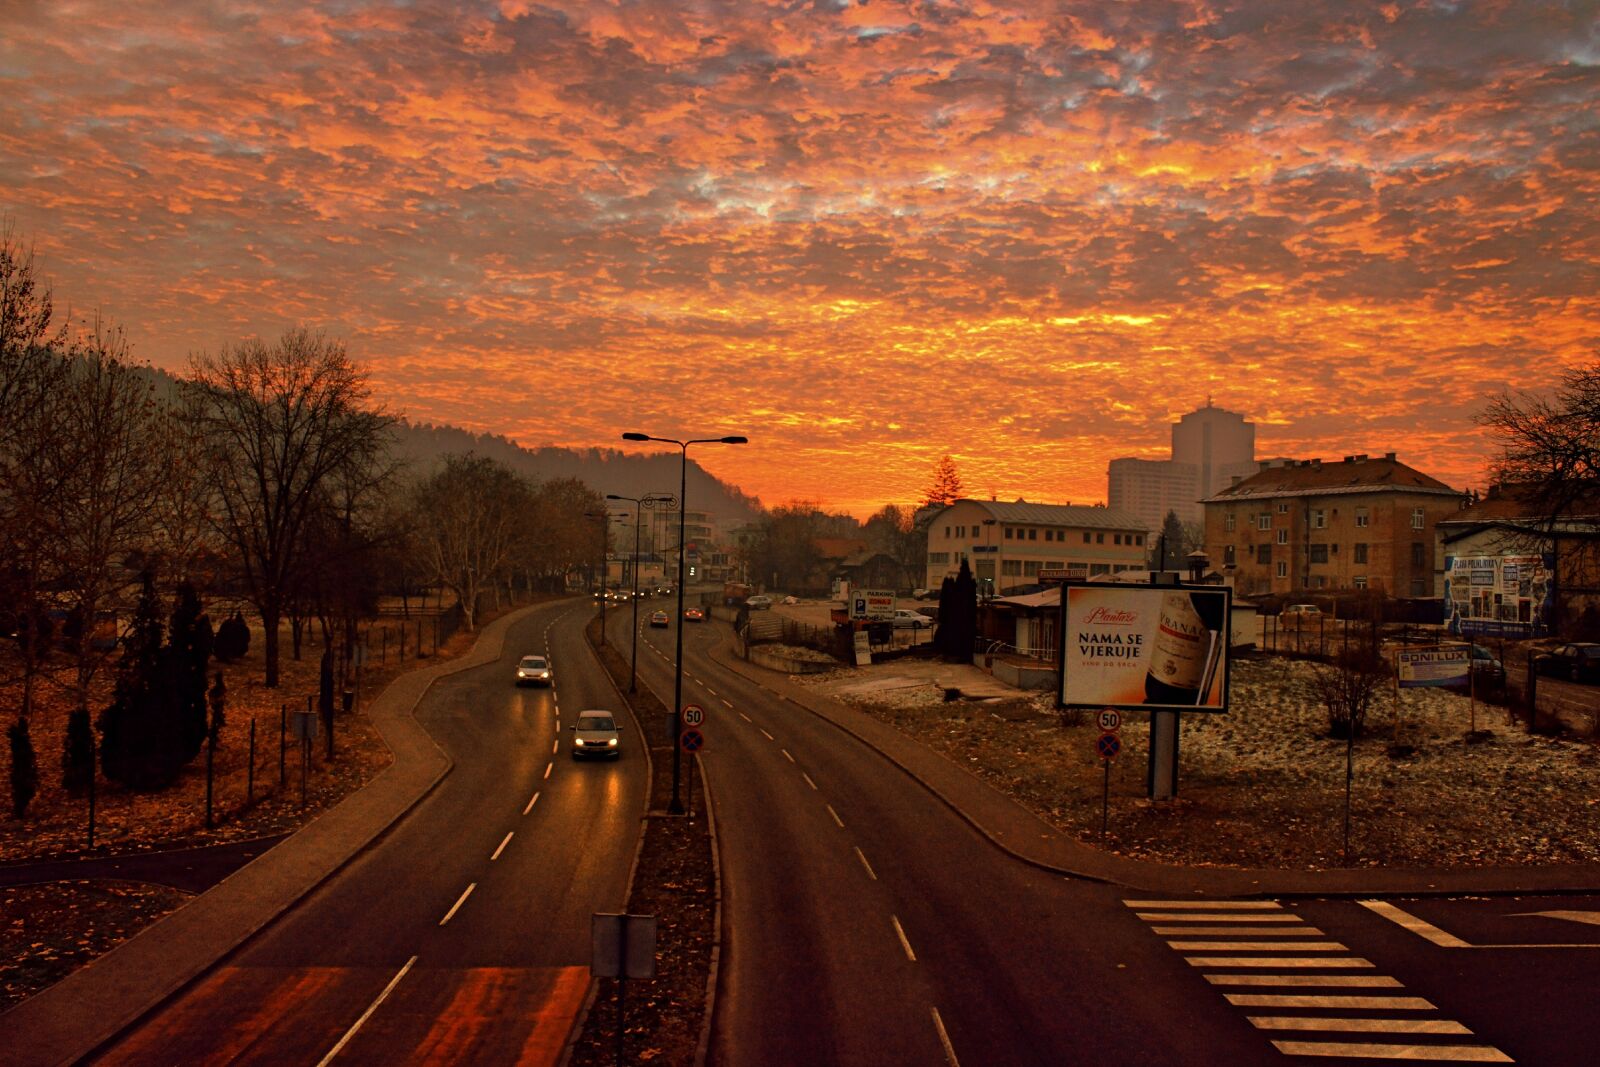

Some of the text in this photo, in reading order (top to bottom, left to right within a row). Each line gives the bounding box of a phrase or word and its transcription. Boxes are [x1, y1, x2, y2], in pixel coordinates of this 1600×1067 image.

[1083, 606, 1138, 624] Plantaže
[1079, 632, 1143, 645] NAMA SE
[1080, 645, 1141, 659] VJERUJE
[1438, 652, 1464, 661] LUX
[687, 710, 701, 723] 50
[1102, 713, 1117, 727] 50
